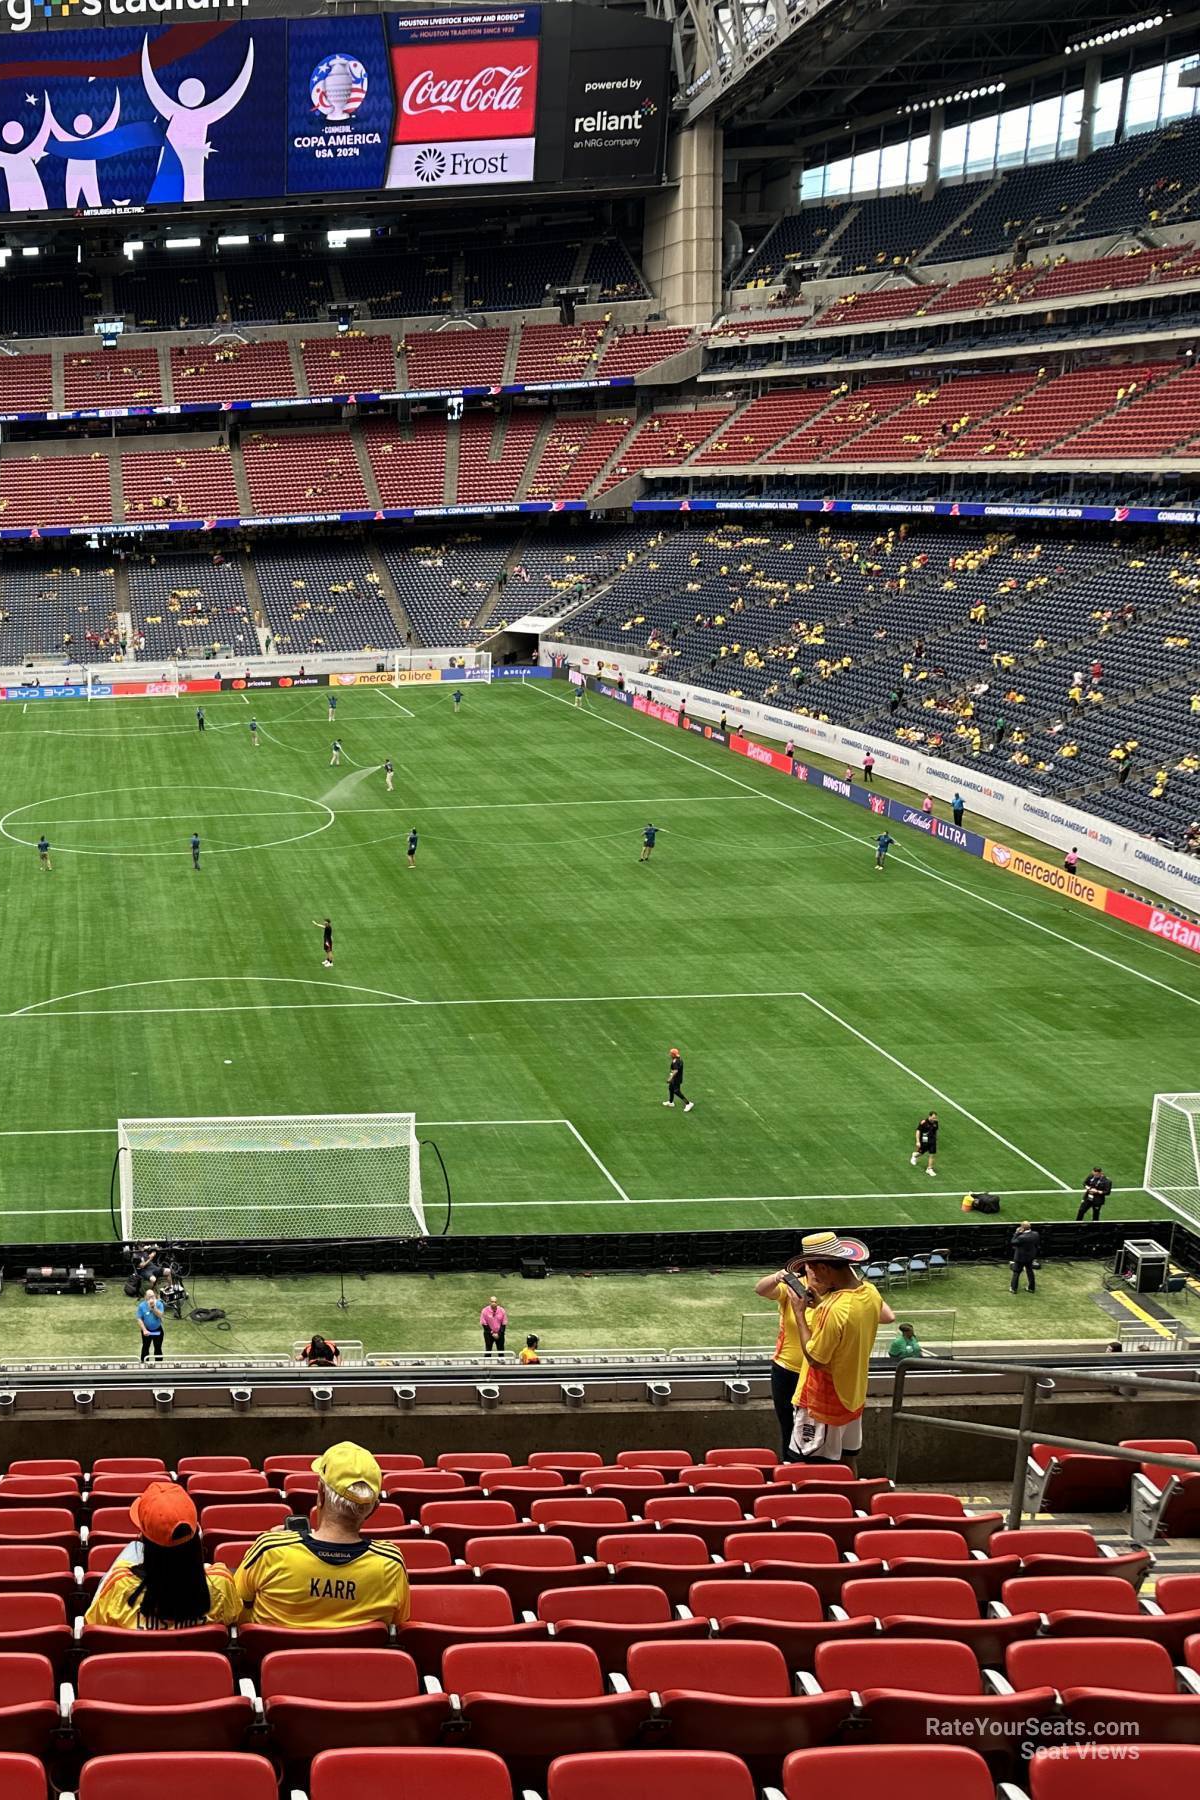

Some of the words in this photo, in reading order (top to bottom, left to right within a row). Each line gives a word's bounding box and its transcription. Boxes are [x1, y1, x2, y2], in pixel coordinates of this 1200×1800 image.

[430, 17, 462, 25] LIVESTOCK
[402, 65, 532, 115] Coca-Cola
[585, 78, 628, 92] powered
[630, 78, 642, 90] by
[574, 110, 642, 132] reliant
[294, 136, 326, 148] COPA
[328, 133, 382, 146] AMERICA
[584, 138, 603, 148] NRG
[604, 138, 640, 148] company
[315, 148, 334, 158] USA
[336, 147, 360, 157] 2024
[450, 152, 508, 175] Frost
[83, 208, 116, 216] MITSUBISHI
[408, 671, 432, 681] libre
[8, 690, 40, 698] BYD
[44, 688, 75, 696] BYD
[823, 775, 850, 797] HOUSTON
[926, 767, 950, 781] CONMEBOL
[951, 776, 962, 785] COPA
[963, 780, 983, 792] AMERICA
[1023, 803, 1050, 820] CONMEBOL
[1051, 814, 1065, 826] COPA
[1065, 820, 1088, 835] AMERICA
[1088, 830, 1098, 840] USA
[938, 823, 967, 846] ULTRA
[1134, 850, 1166, 870] CONMEBOL
[1167, 862, 1183, 877] COPA
[1014, 857, 1064, 889] mercado
[1067, 874, 1095, 901] libre
[310, 1578, 356, 1600] KARR
